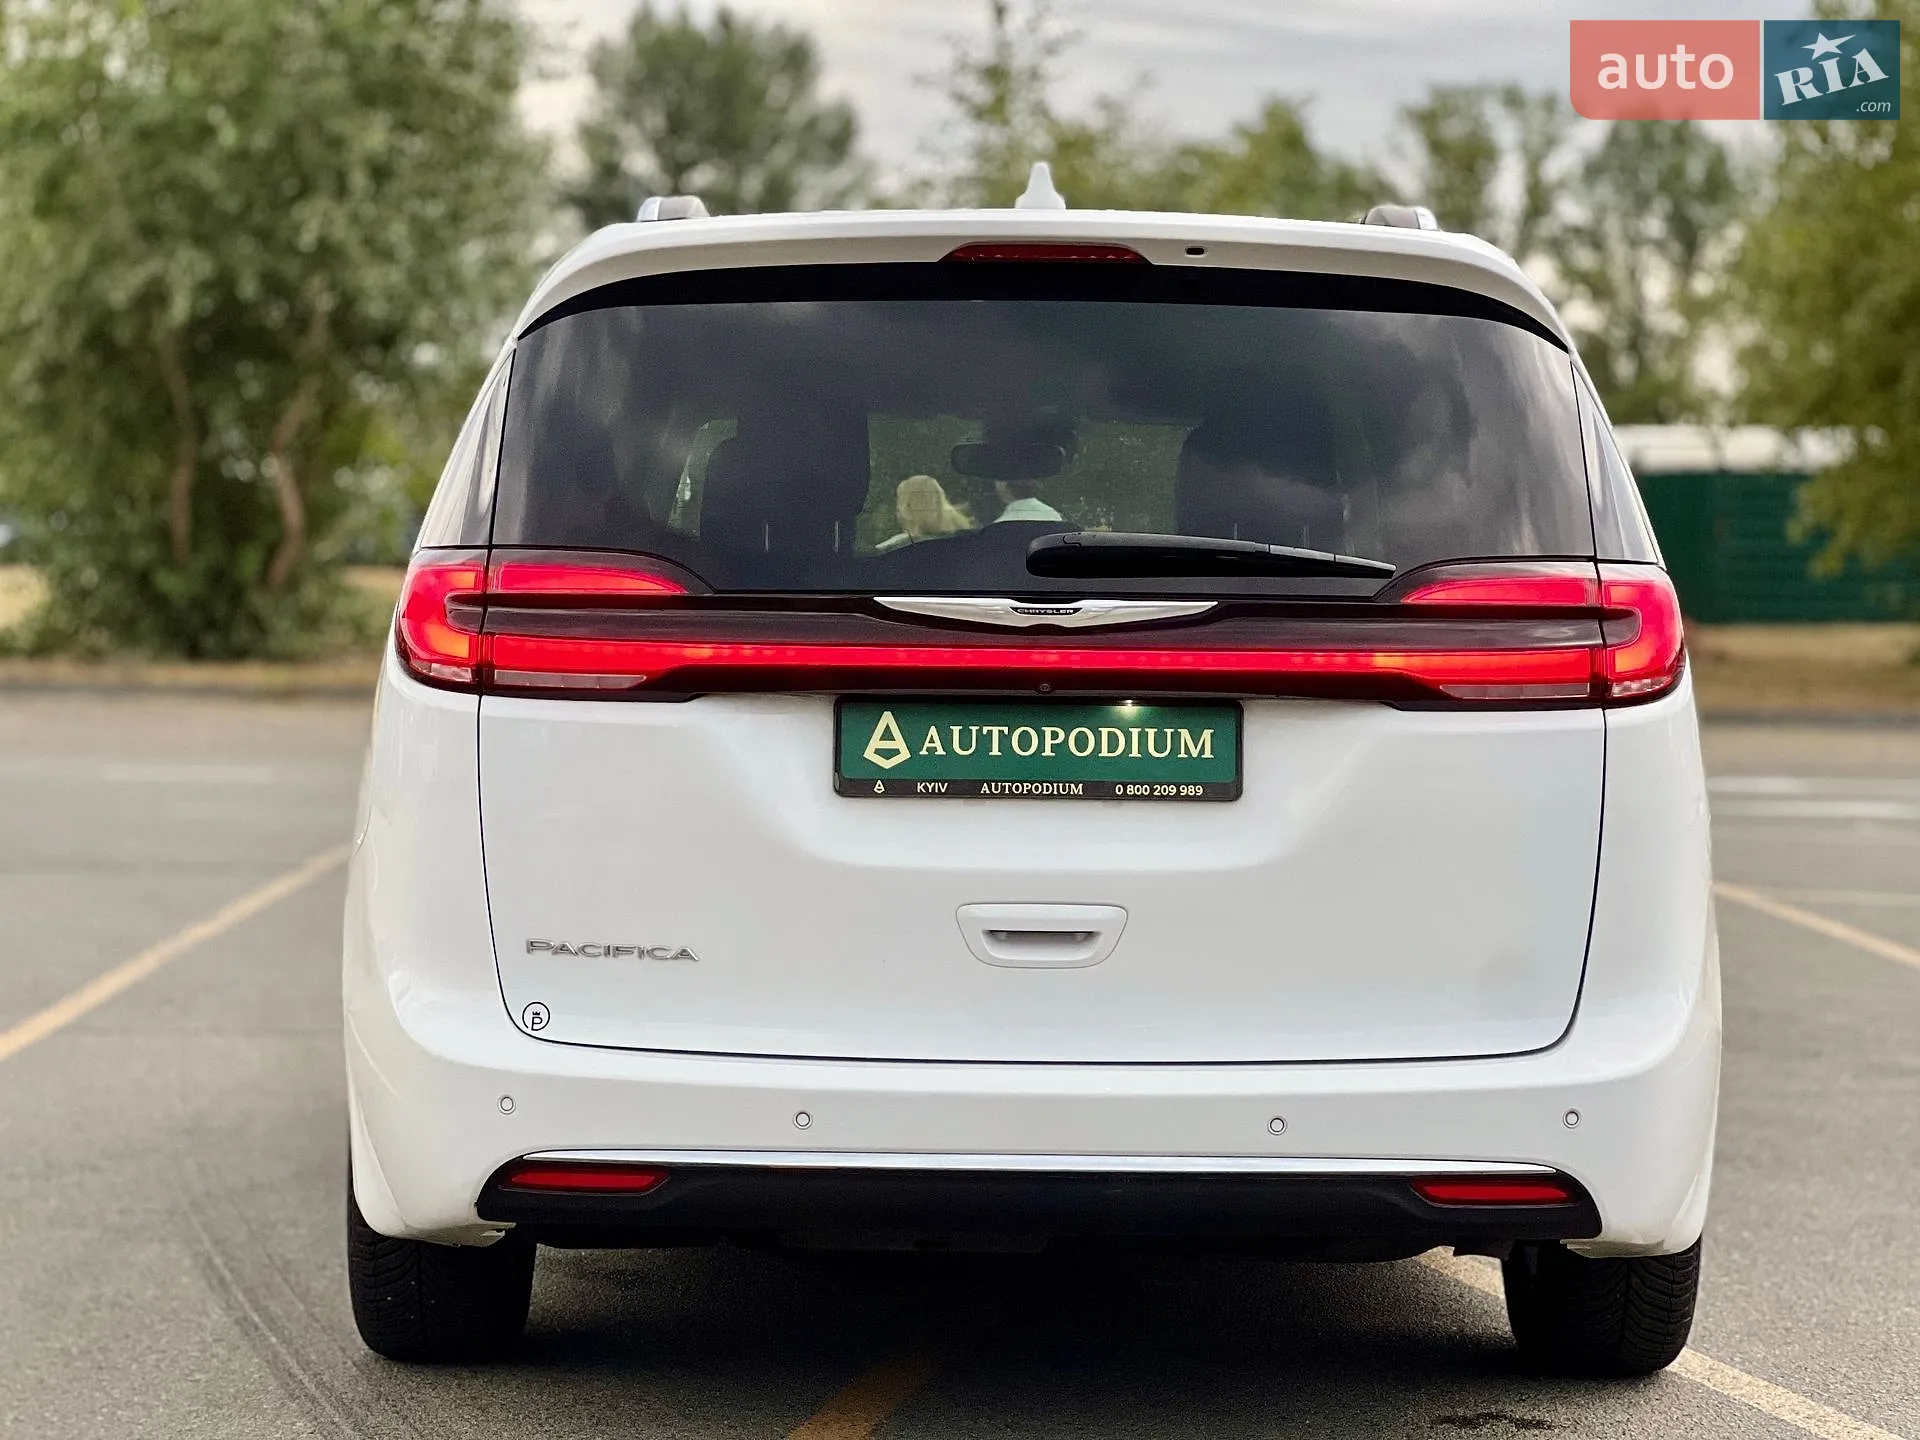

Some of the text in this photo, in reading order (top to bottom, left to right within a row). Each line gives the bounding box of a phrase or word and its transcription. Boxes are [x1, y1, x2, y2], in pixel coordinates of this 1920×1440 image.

[919, 725, 1215, 760] AUTOPODIUM
[916, 782, 949, 794] KYIV
[980, 782, 1084, 795] AUTOPODIUM
[1115, 784, 1204, 796] 0 800 209 989
[526, 938, 700, 962] PACIFICA
